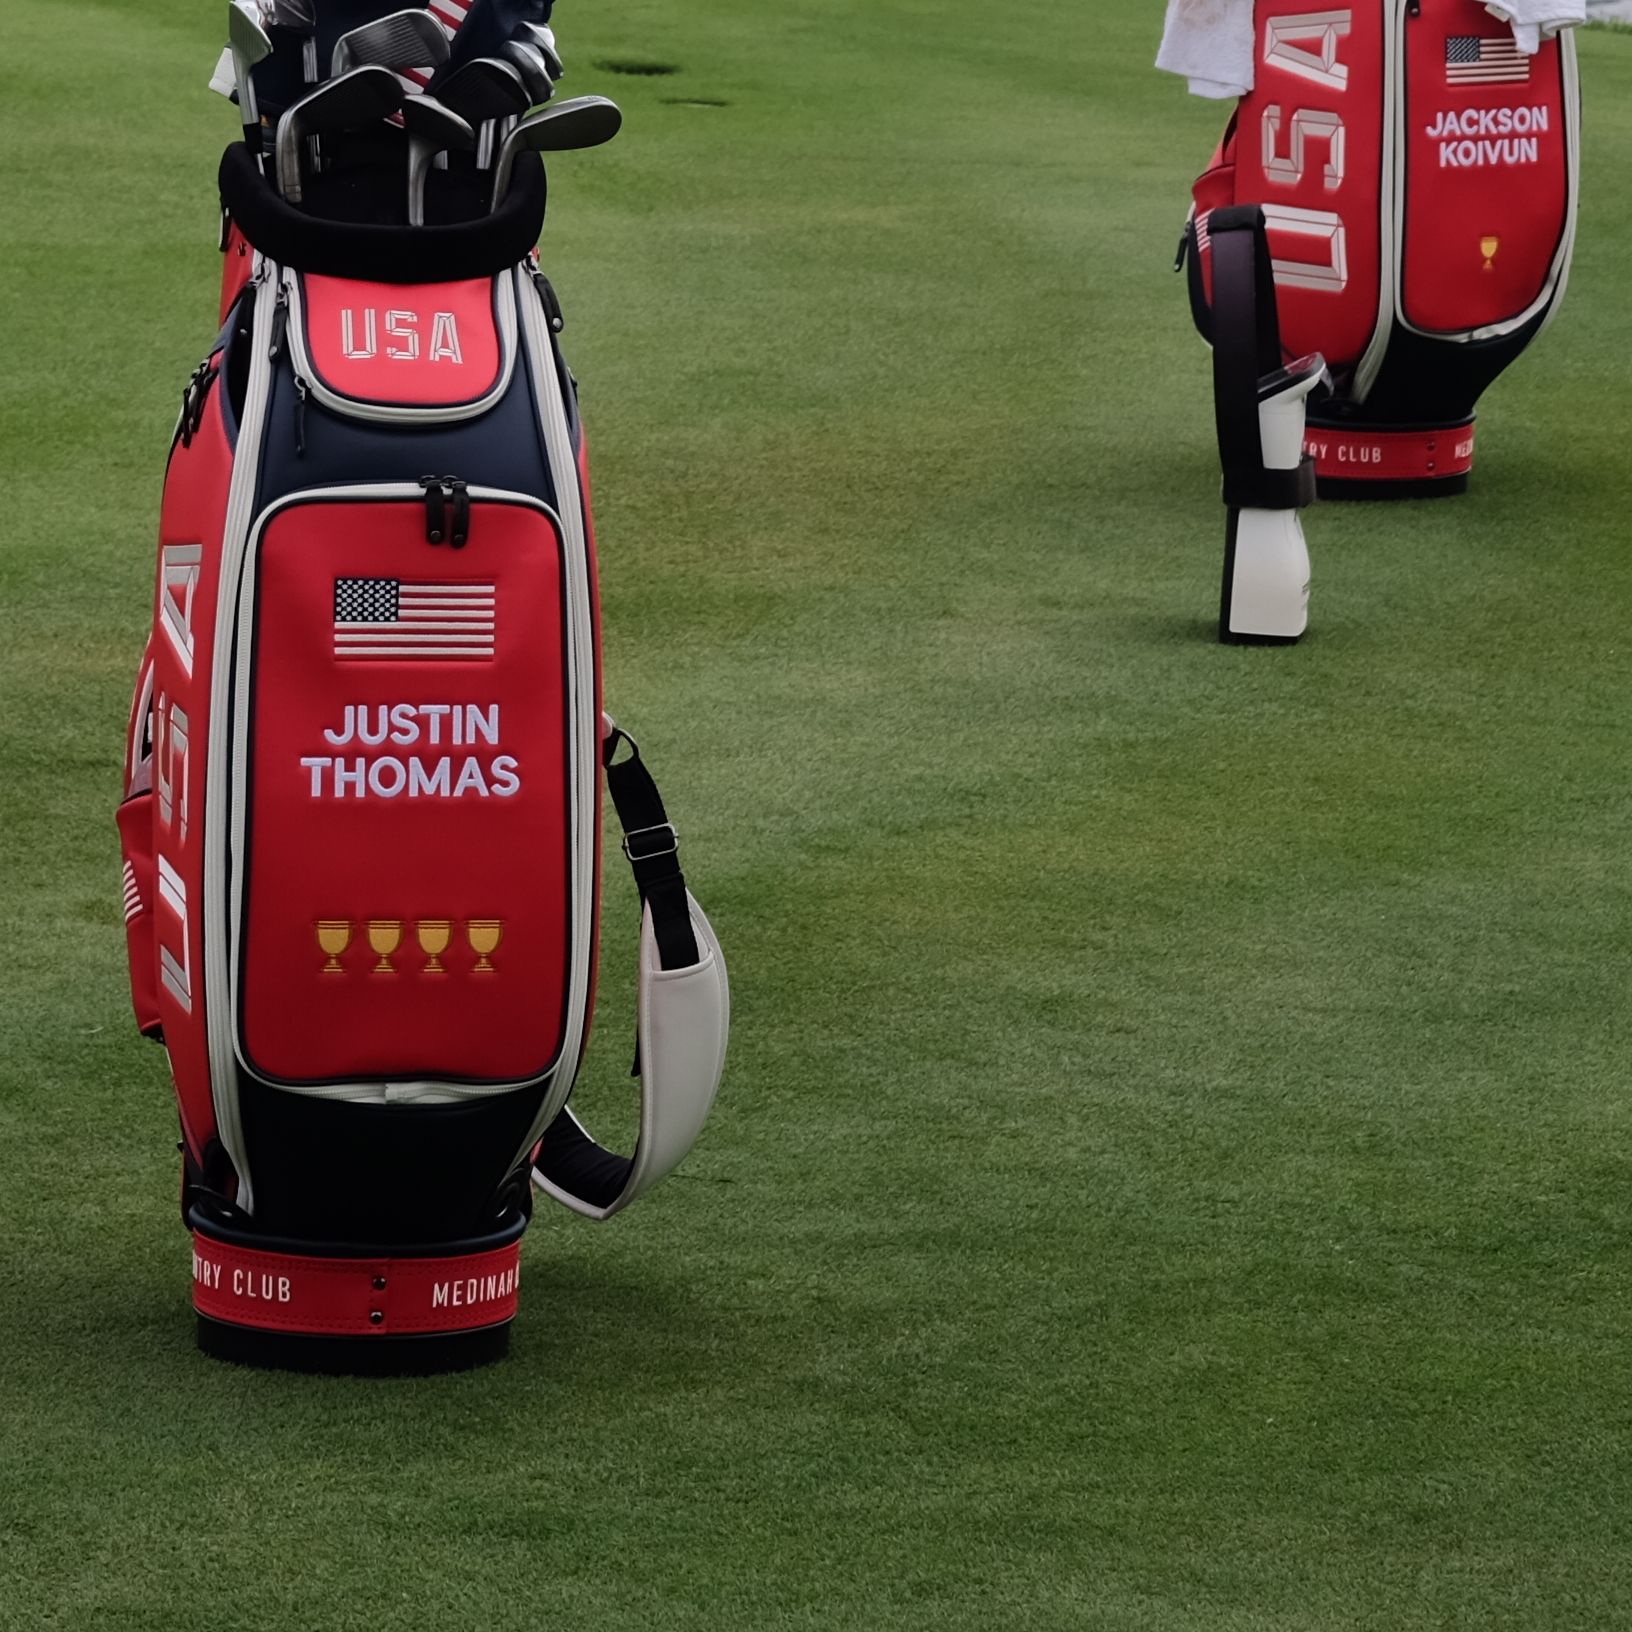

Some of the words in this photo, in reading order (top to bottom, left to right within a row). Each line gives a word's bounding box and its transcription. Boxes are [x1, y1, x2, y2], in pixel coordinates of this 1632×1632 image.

[1426, 105, 1549, 137] JACKSON
[1262, 9, 1352, 294] USA
[1439, 137, 1538, 168] KOIVUN
[341, 308, 464, 365] USA
[1338, 445, 1382, 463] CLUB
[324, 703, 500, 746] JUSTIN
[158, 543, 204, 1015] USA
[300, 754, 521, 799] THOMAS
[233, 1268, 292, 1302] CLUB
[432, 1268, 514, 1308] MEDINAH
